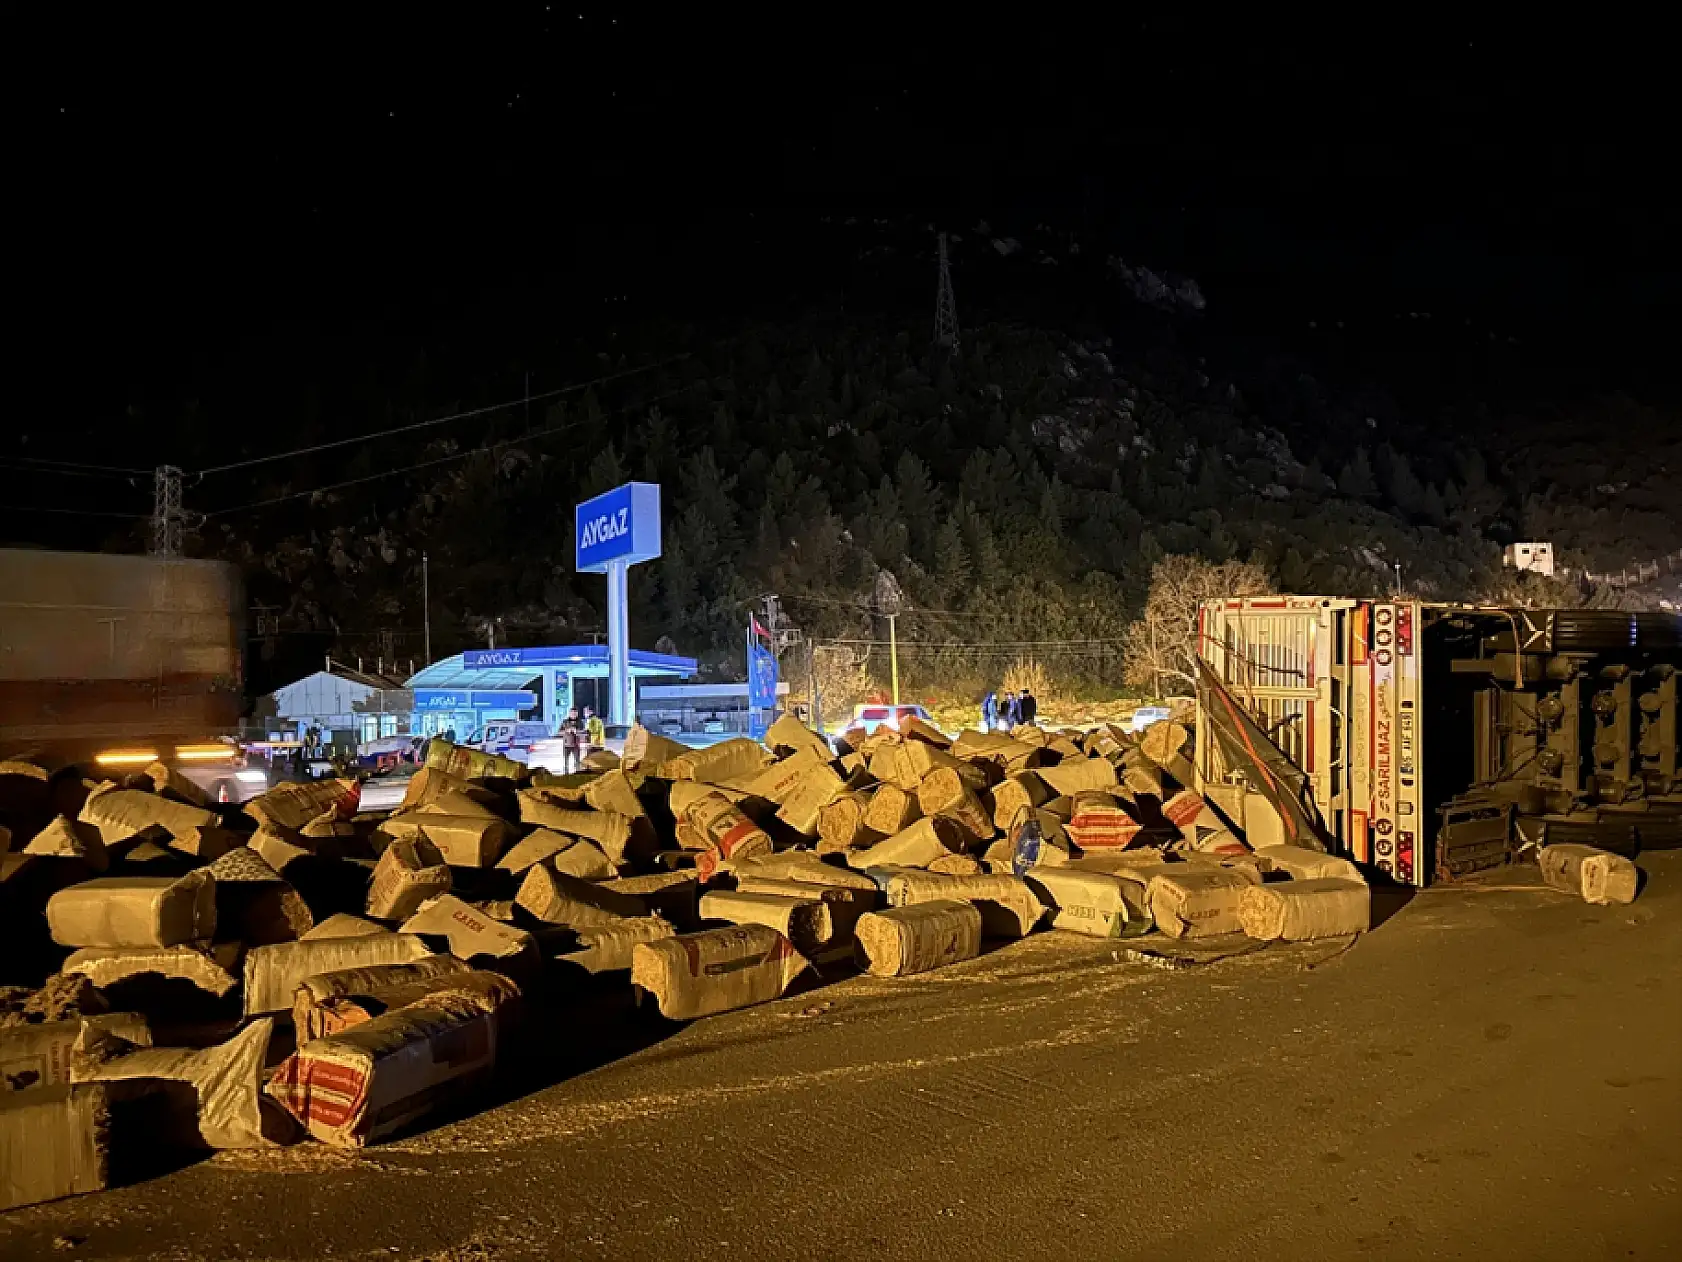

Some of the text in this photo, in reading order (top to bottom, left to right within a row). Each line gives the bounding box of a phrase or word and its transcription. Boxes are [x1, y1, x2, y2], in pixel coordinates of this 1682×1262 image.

[581, 507, 628, 549] AYGAZ
[477, 652, 520, 665] AYGAZ
[1378, 720, 1390, 799] SARILMAZ
